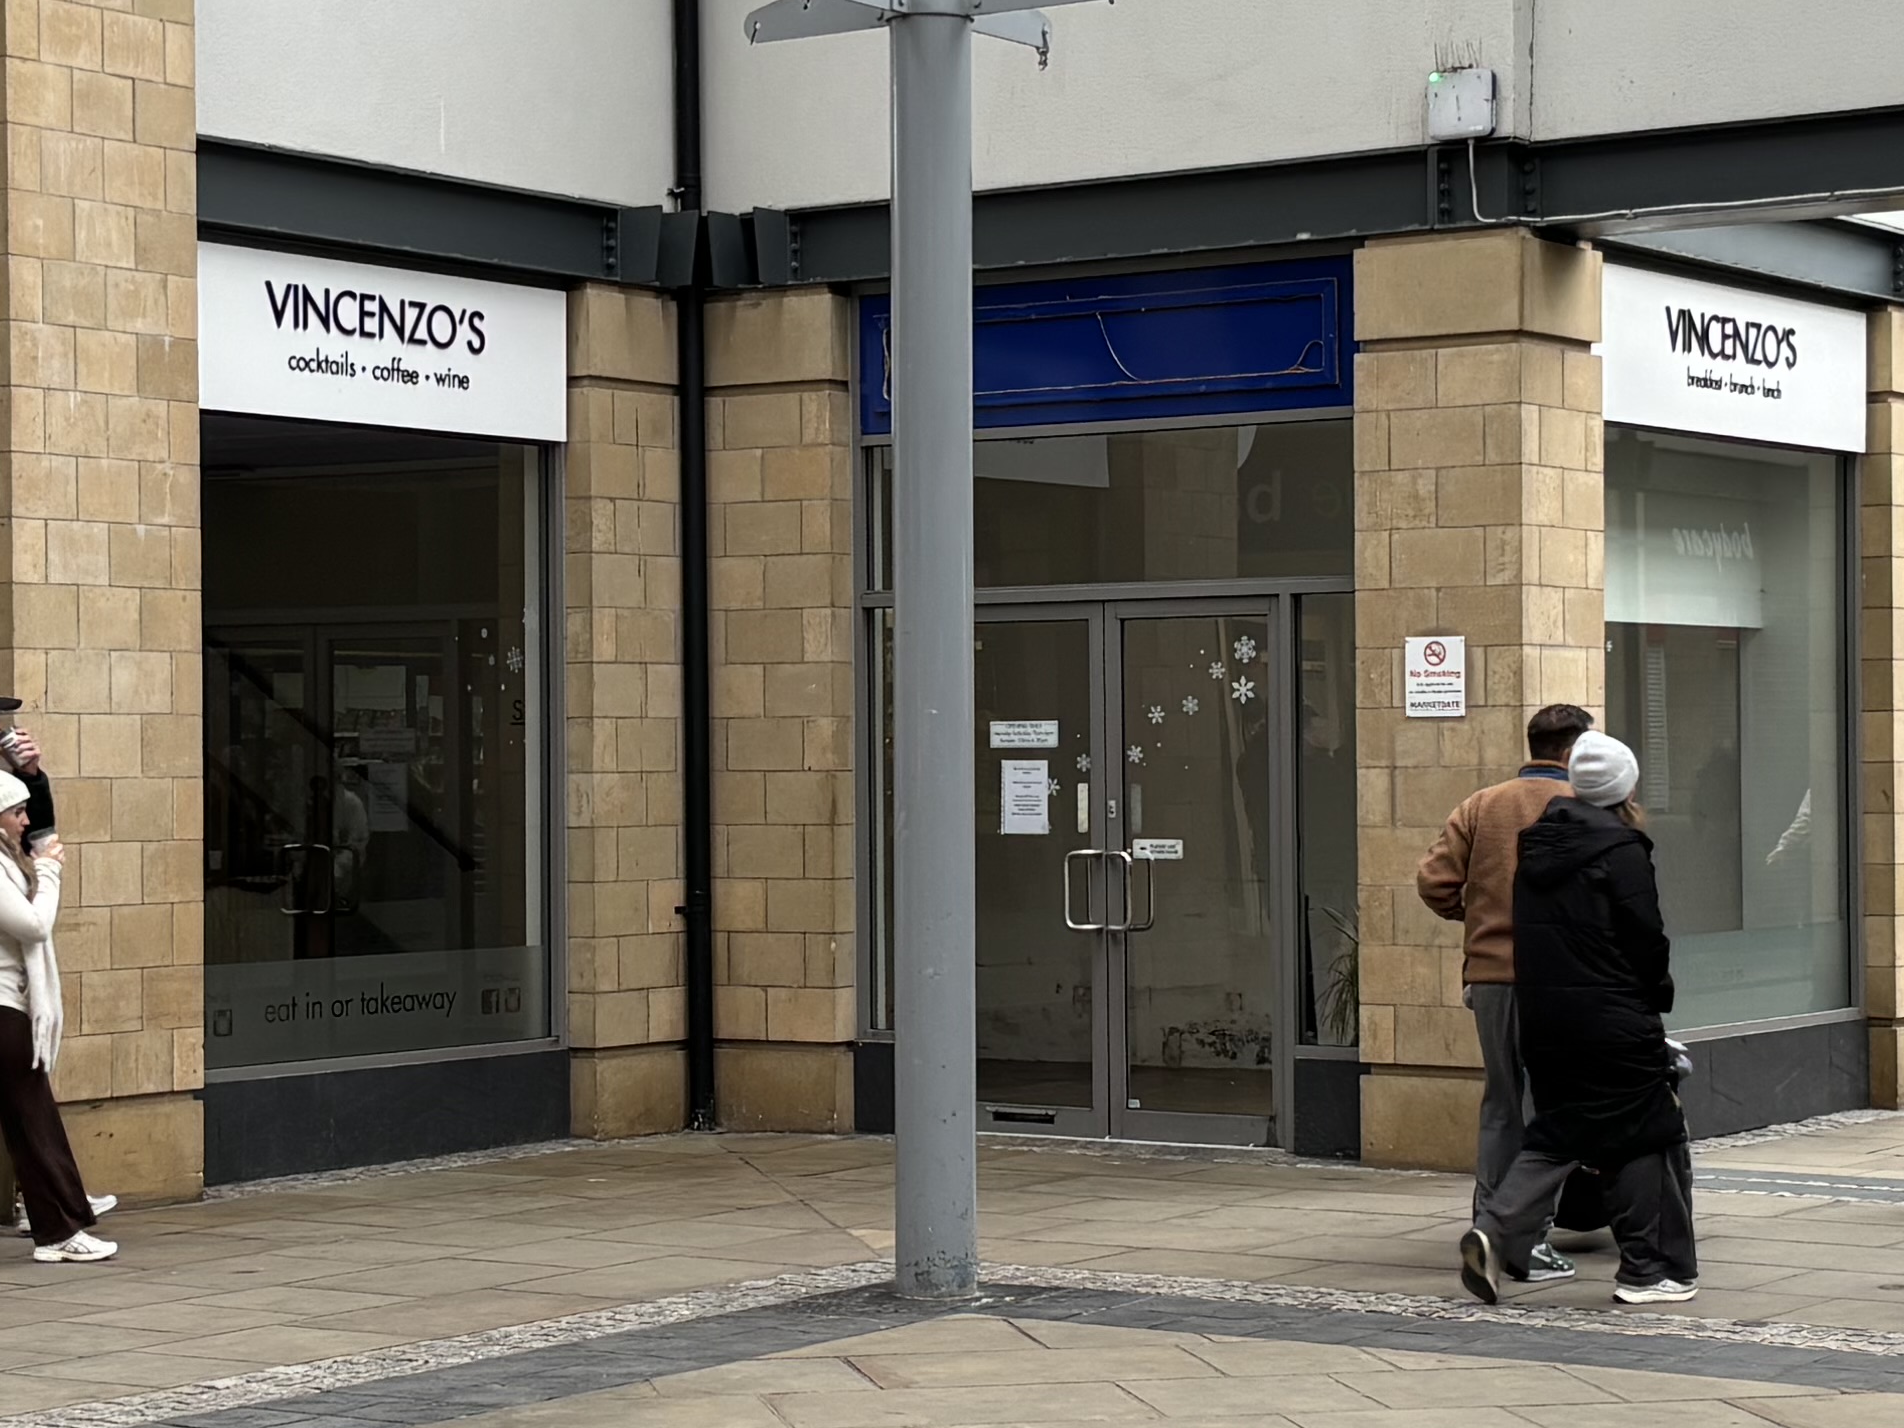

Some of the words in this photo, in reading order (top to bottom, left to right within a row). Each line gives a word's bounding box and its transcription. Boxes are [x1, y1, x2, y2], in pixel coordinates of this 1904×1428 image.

[264, 280, 486, 356] VINCENZO'S
[1665, 305, 1797, 370] VINCENZO'S
[287, 346, 357, 378] cocktails
[372, 357, 419, 386] coffee
[434, 367, 470, 390] wine
[264, 995, 297, 1023] eat
[305, 991, 323, 1020] in
[331, 997, 352, 1018] or
[360, 981, 457, 1018] takeaway
